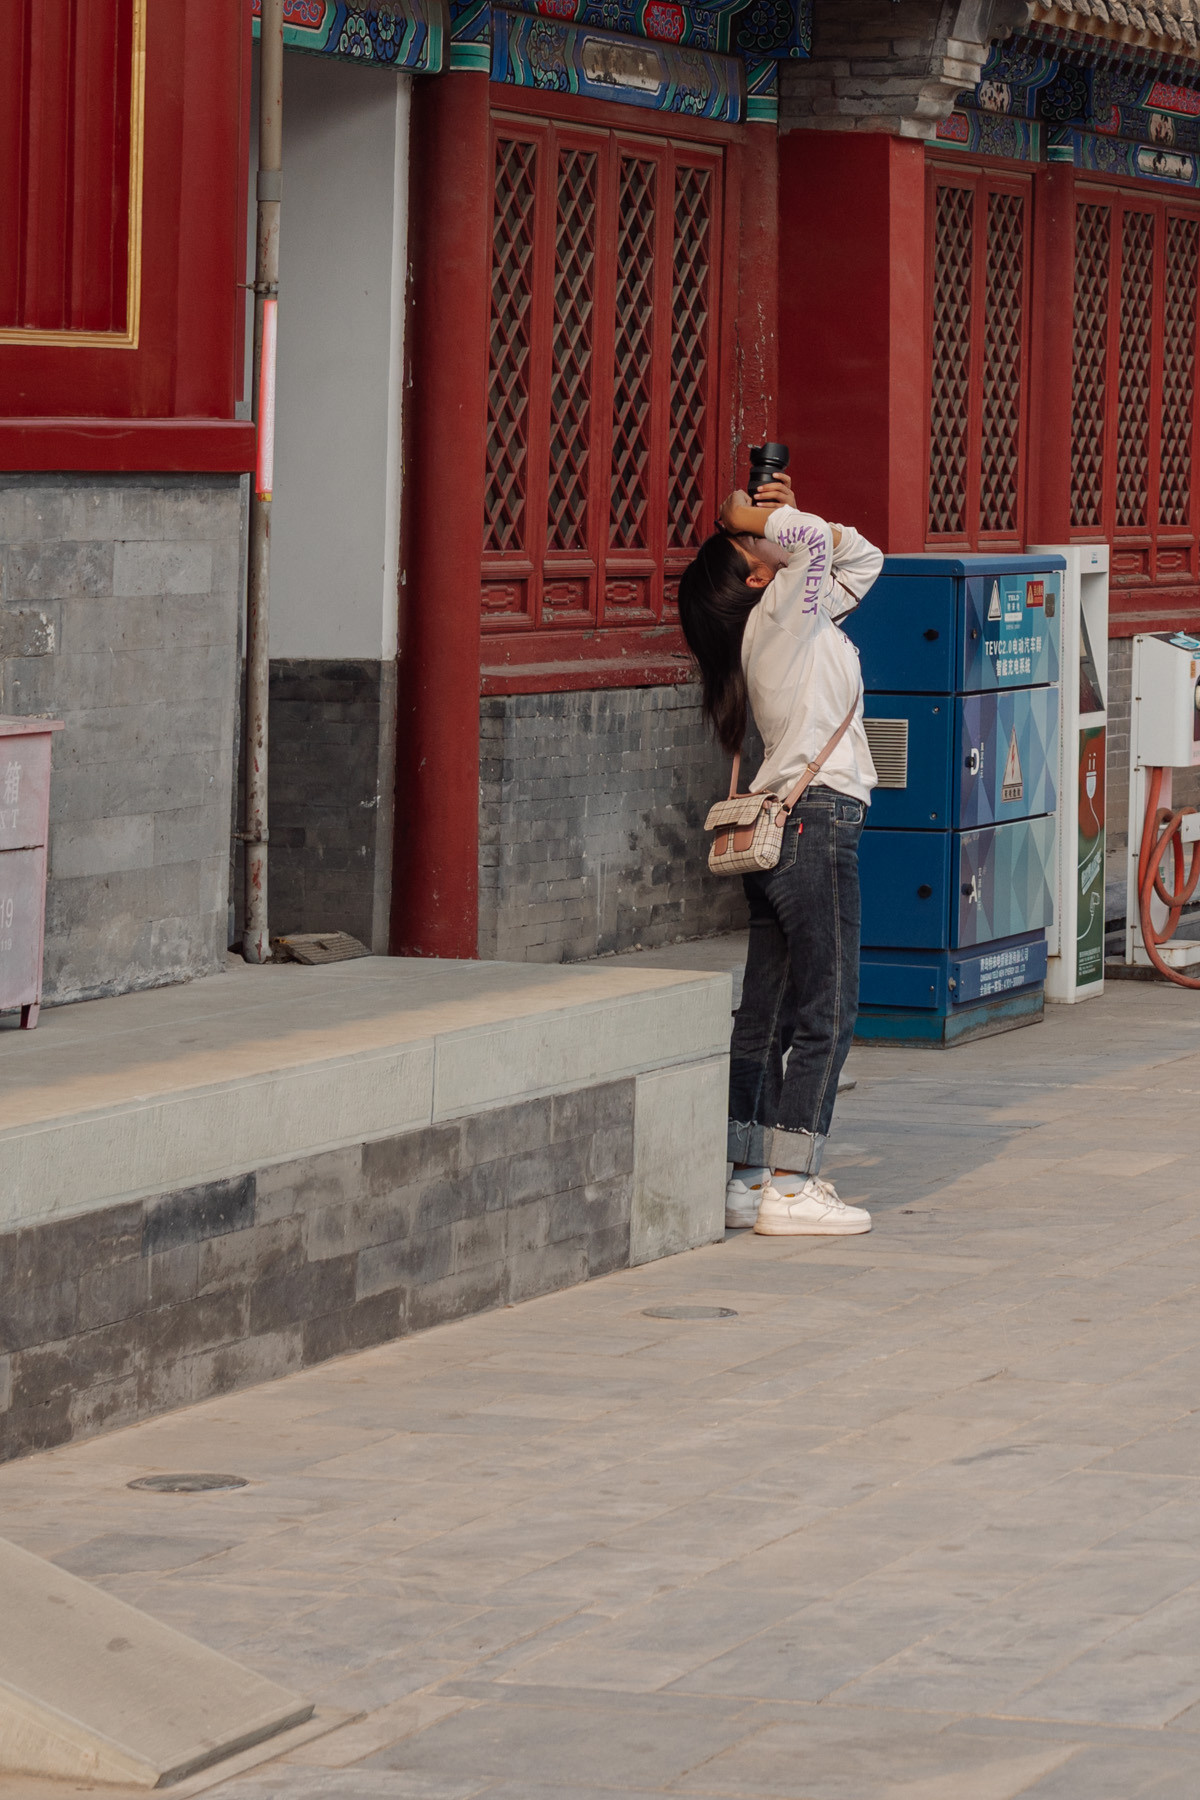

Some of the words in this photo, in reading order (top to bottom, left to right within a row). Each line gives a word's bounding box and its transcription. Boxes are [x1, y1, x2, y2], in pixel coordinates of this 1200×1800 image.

[996, 657, 1031, 677] 智能充电系统
[3, 761, 22, 804] 箱
